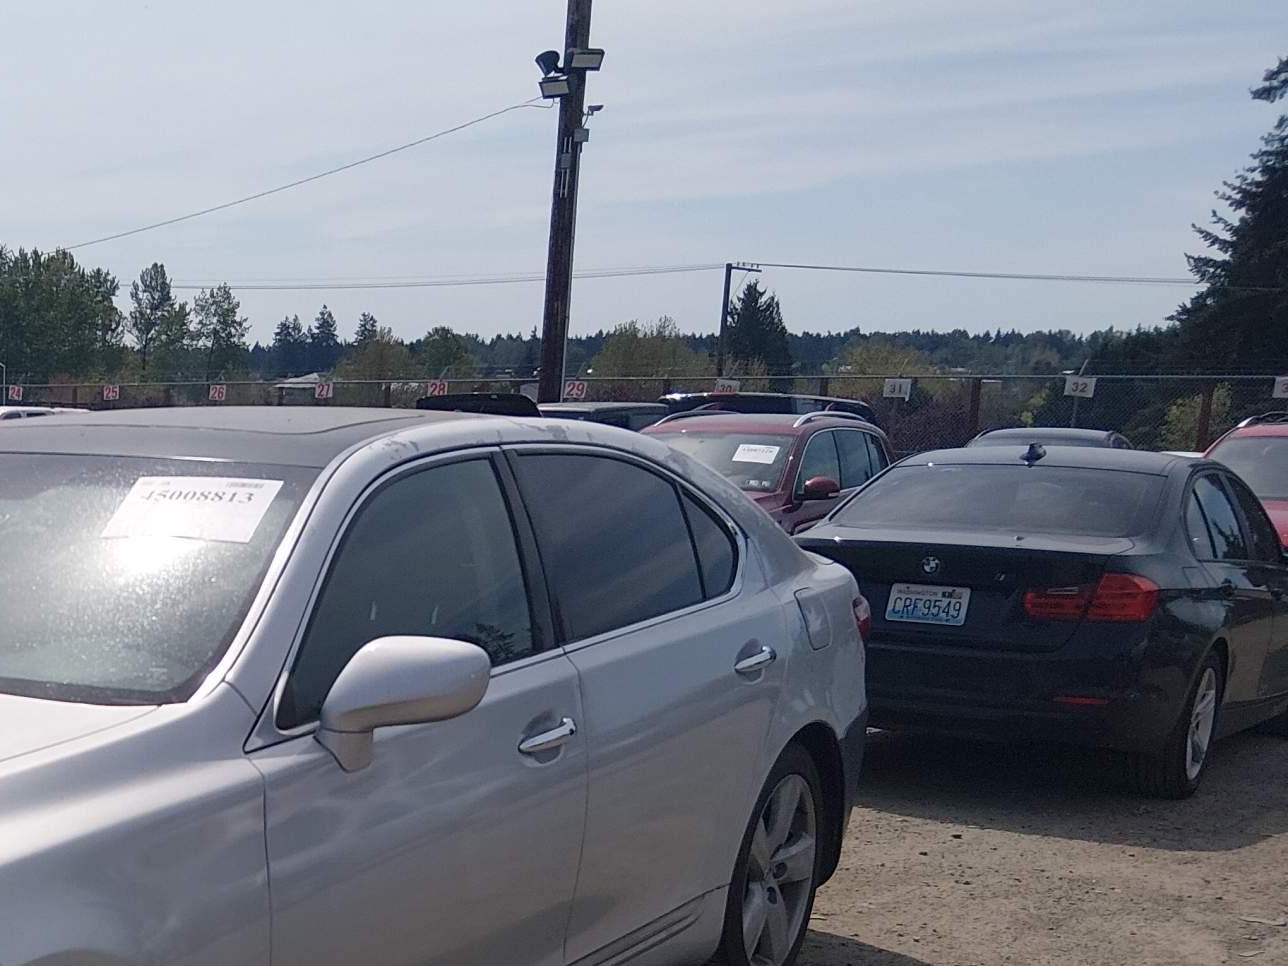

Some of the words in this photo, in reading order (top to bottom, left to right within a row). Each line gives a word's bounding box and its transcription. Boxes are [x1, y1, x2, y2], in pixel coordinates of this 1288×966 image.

[10, 386, 22, 399] 24
[105, 386, 118, 399] 25
[211, 385, 224, 399] 26
[317, 384, 330, 397] 27
[430, 382, 446, 395] 28
[567, 382, 585, 396] 29
[889, 382, 902, 394] 31
[1072, 382, 1088, 394] 32
